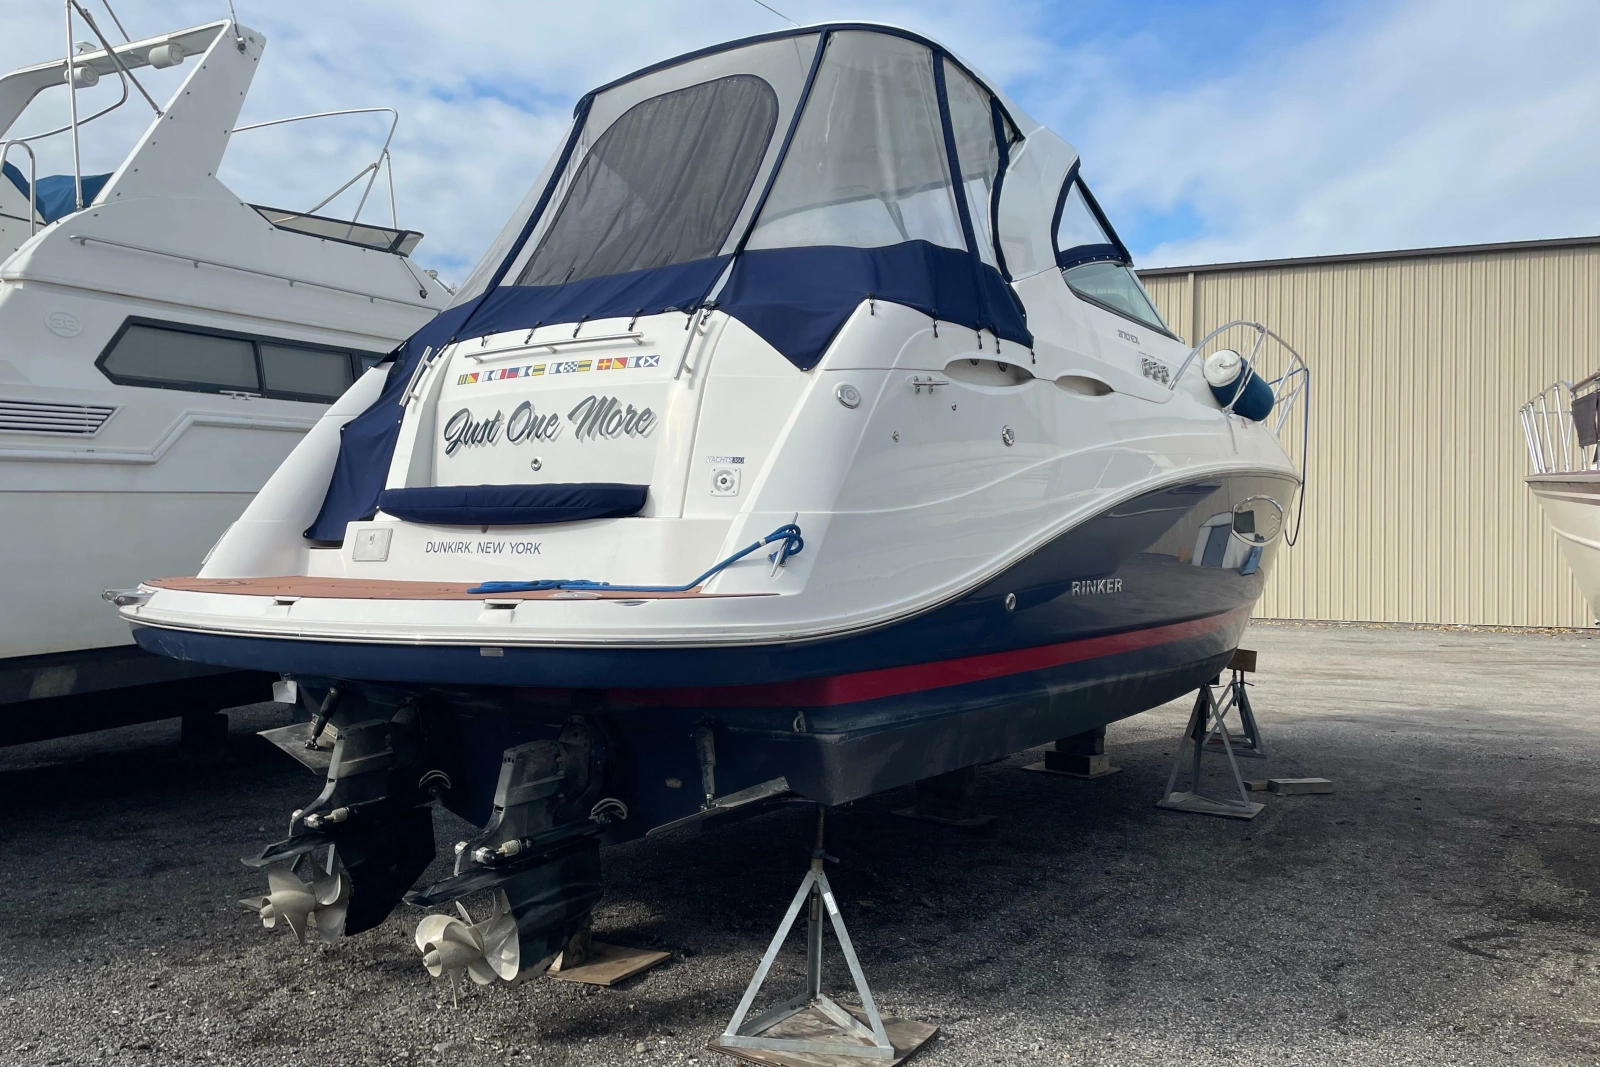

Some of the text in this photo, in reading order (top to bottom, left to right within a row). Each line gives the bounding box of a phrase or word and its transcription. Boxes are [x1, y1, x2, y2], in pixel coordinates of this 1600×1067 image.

[443, 394, 659, 459] Just One More
[476, 541, 505, 554] NEW
[509, 542, 542, 555] YORK
[1071, 578, 1123, 597] RINKER
